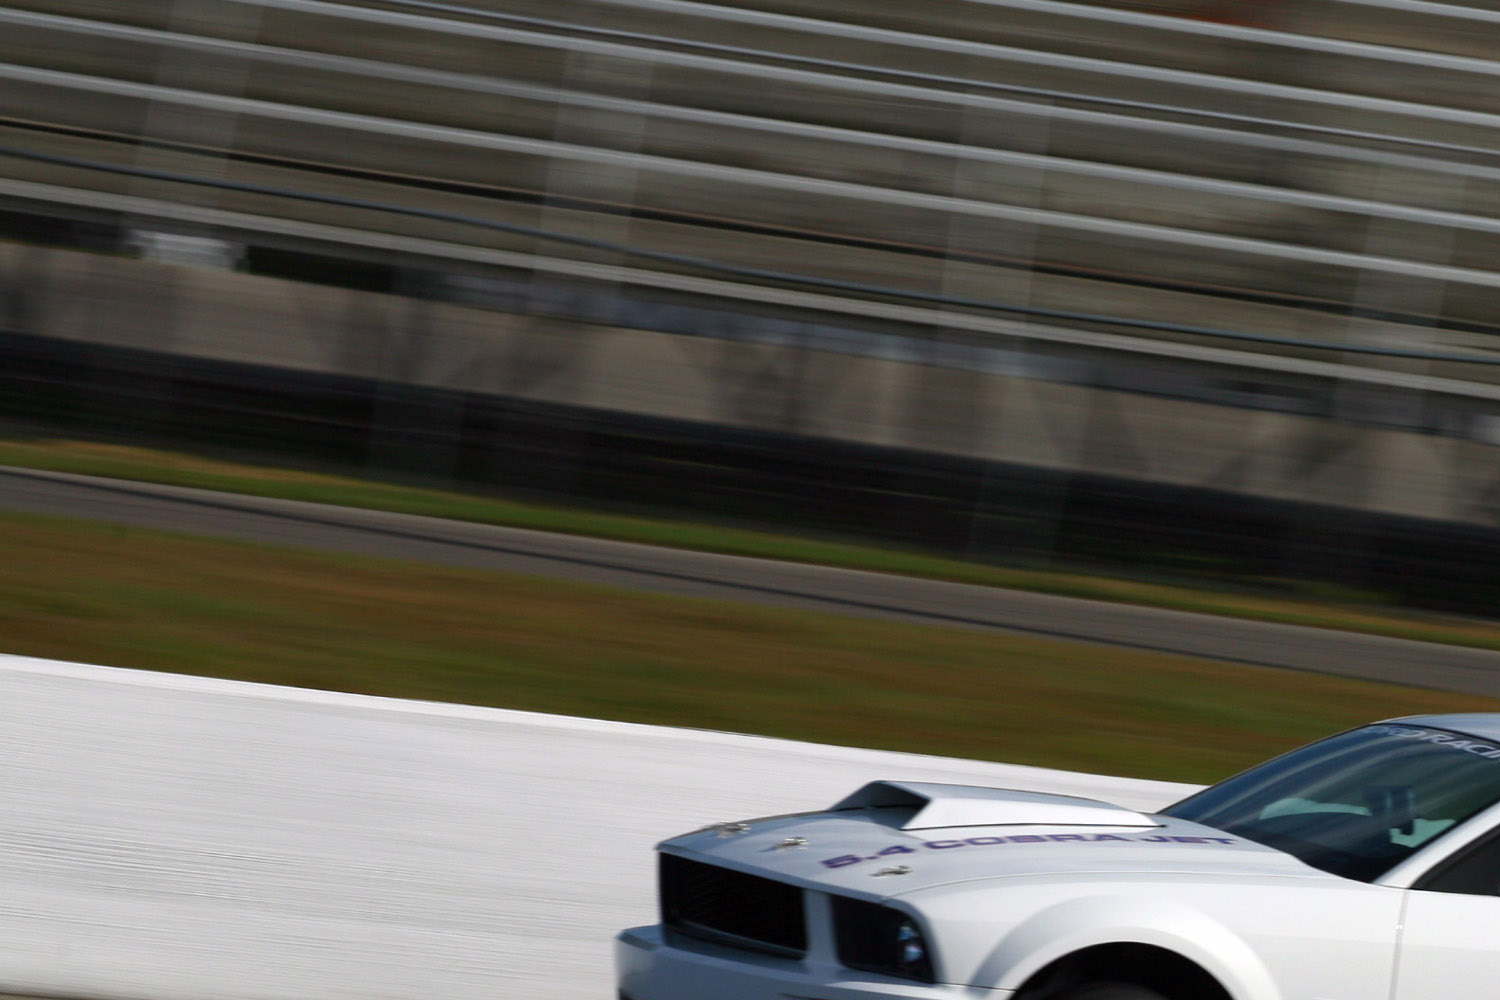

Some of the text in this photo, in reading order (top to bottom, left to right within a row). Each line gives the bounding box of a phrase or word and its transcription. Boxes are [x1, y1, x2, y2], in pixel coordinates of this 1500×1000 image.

[821, 833, 1238, 869] 5.4 COBRA JET
